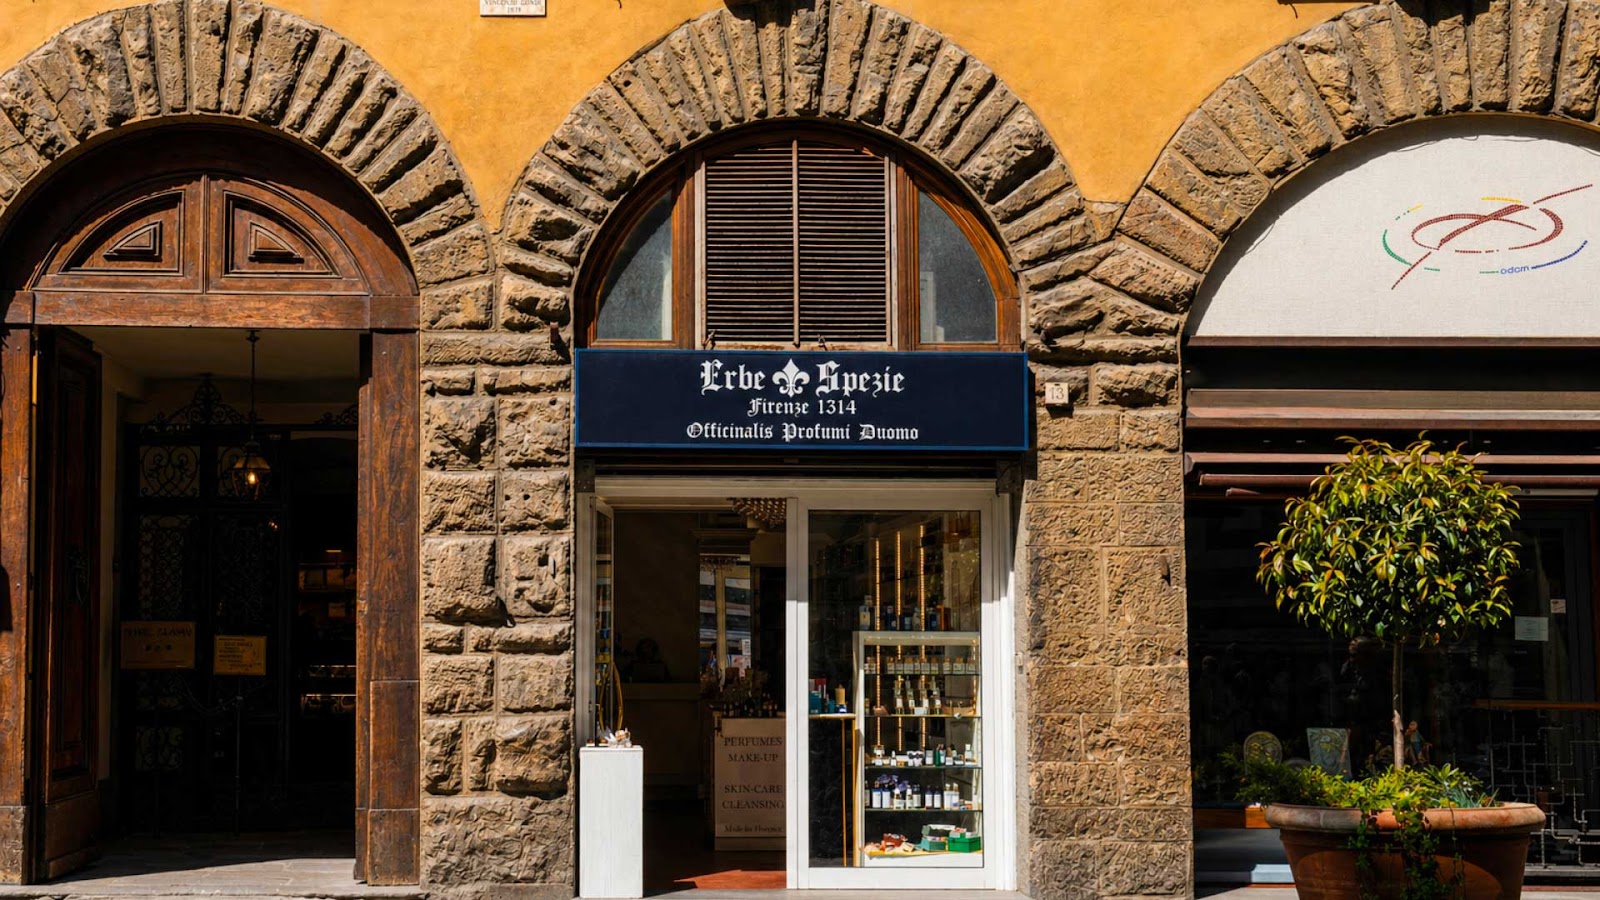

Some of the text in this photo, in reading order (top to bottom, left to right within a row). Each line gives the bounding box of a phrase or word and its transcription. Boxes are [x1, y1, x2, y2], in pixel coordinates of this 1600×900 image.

[700, 358, 905, 398] Erbe Spezie
[1049, 387, 1065, 400] 13
[747, 398, 857, 417] Firenze 1314
[686, 422, 919, 442] Officinalis Profumi Duomo
[724, 736, 782, 747] PERFUMES
[728, 753, 779, 762] MAKE-UP
[724, 784, 783, 794] SKIN-CARE
[722, 799, 785, 809] CLEANSING
